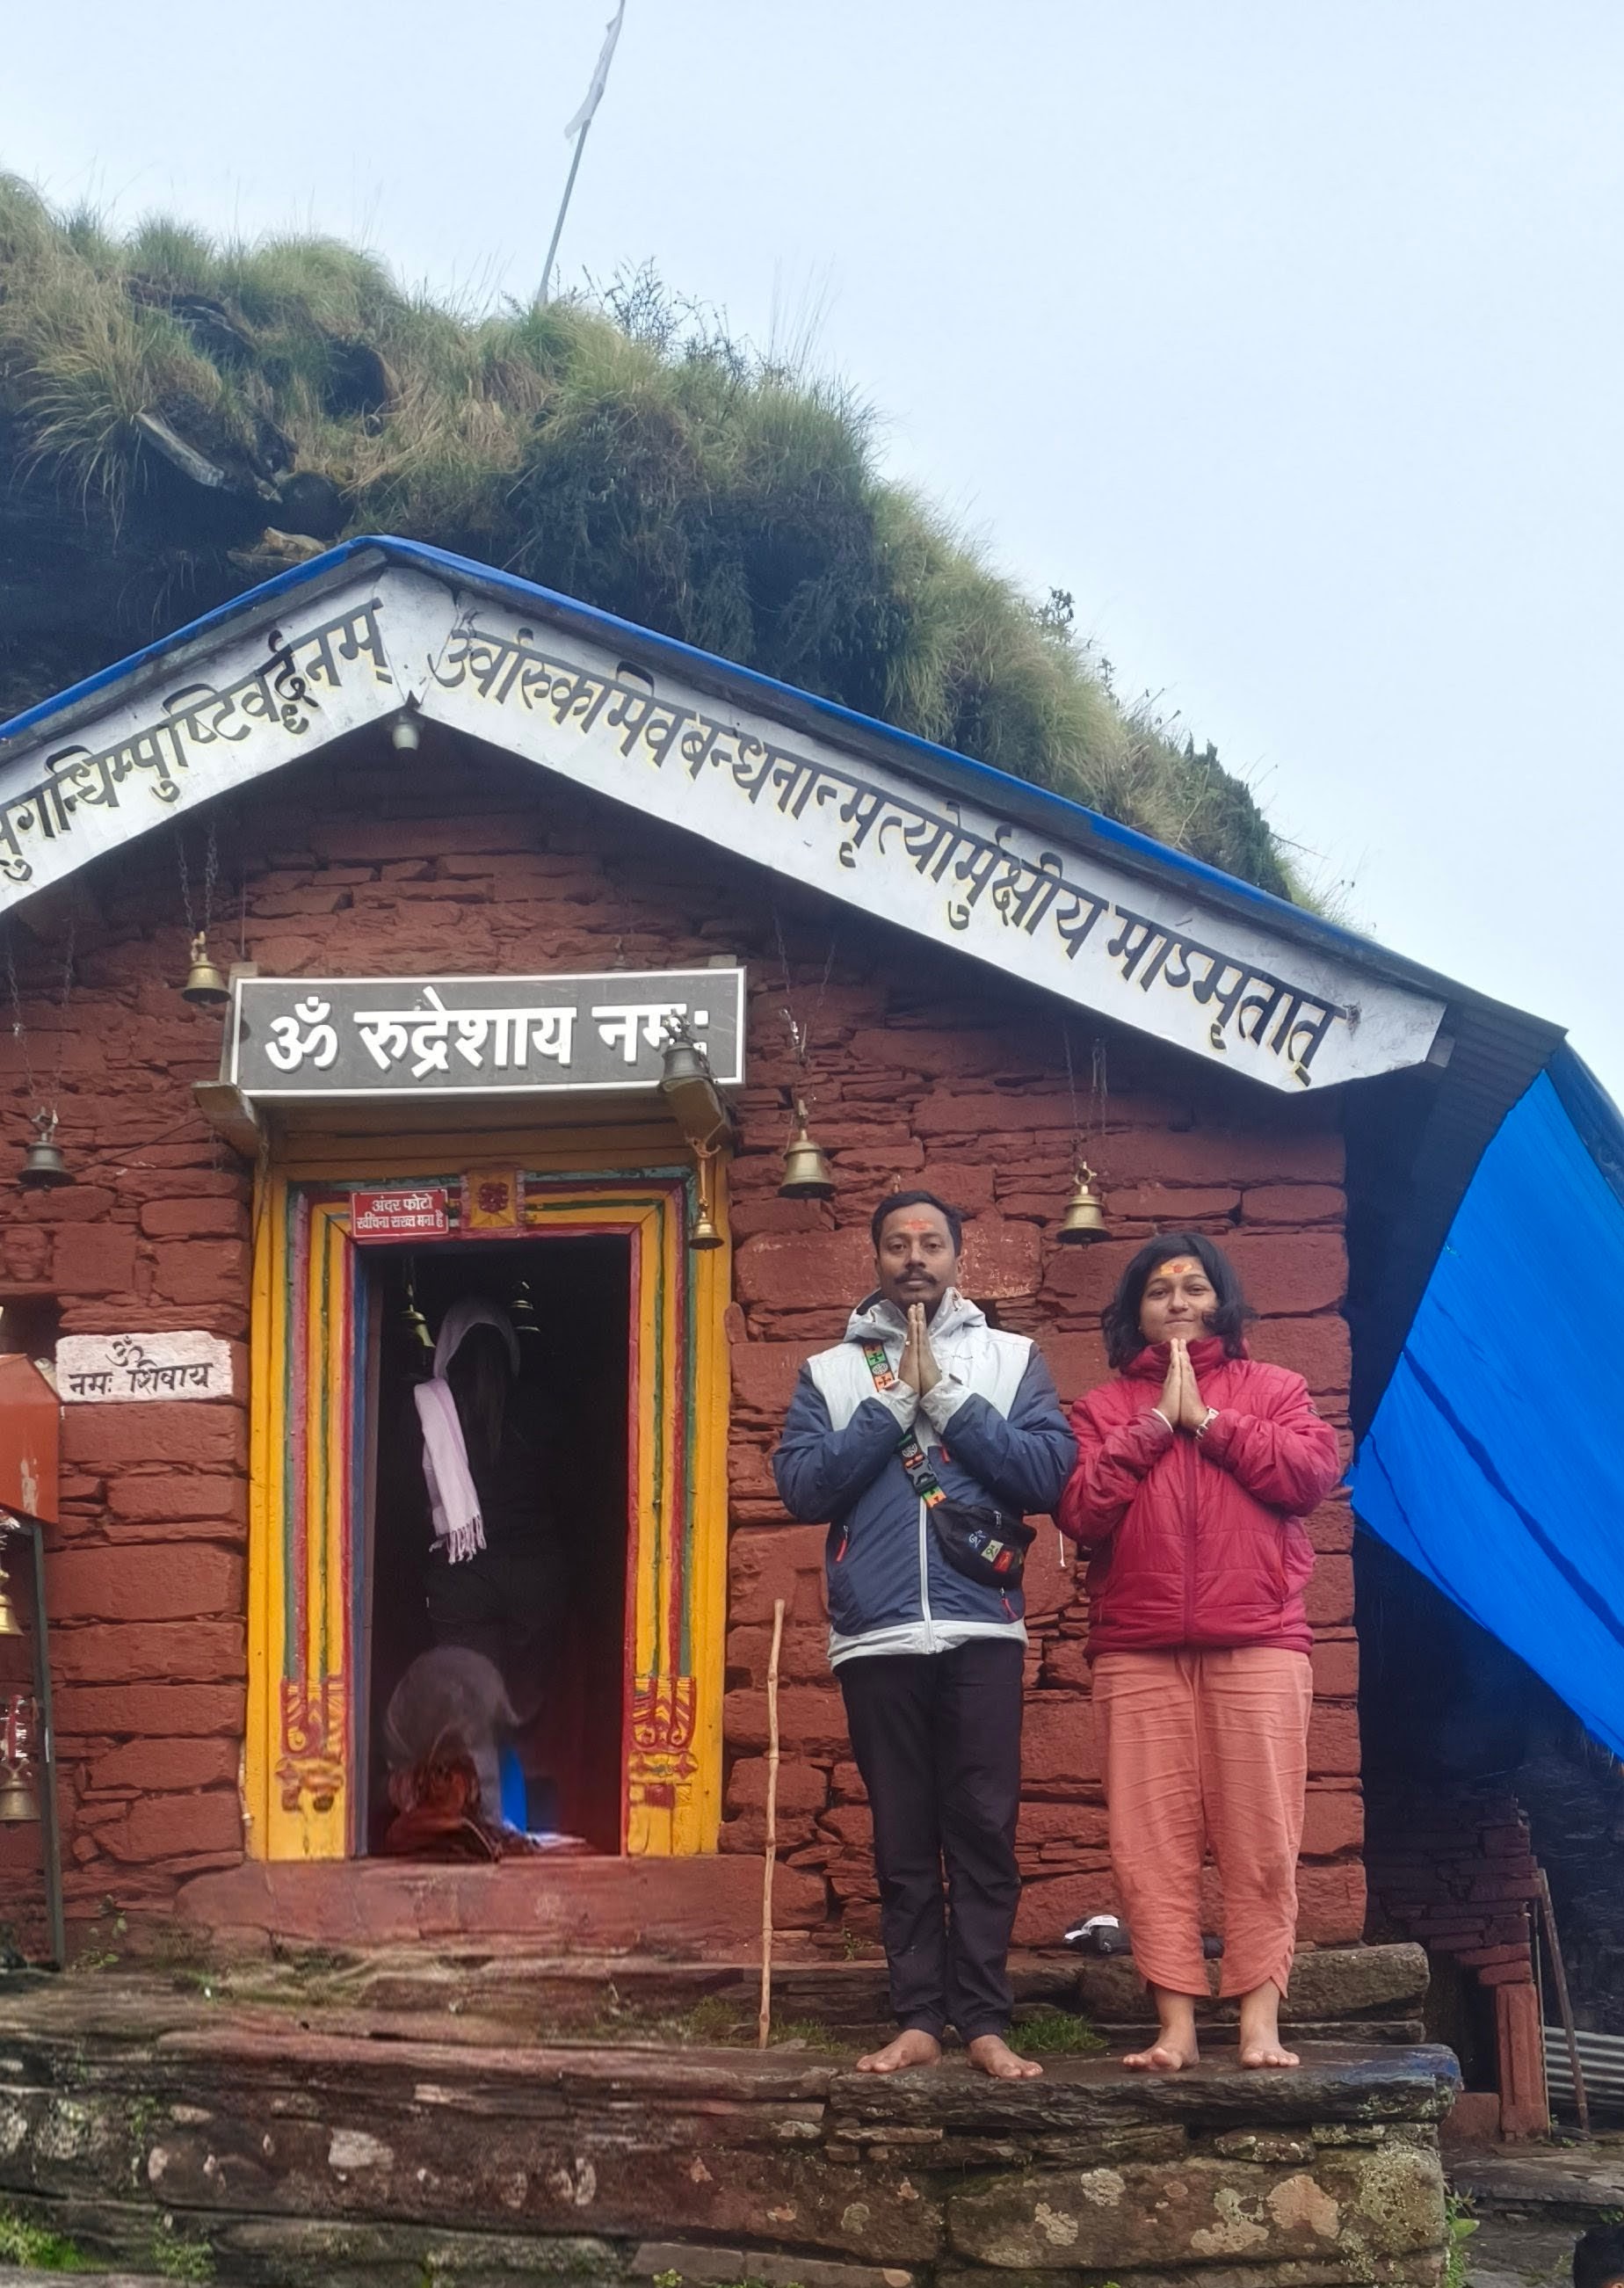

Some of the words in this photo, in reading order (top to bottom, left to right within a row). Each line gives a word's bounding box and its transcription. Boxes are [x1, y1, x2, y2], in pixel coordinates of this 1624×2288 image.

[265, 996, 338, 1073] ॐ
[353, 985, 577, 1080] रुद्रेशाय
[373, 1195, 402, 1212] अंदर
[403, 1193, 433, 1210] फोटो
[390, 1215, 416, 1228] सख्त
[417, 1214, 434, 1226] मना
[435, 1209, 444, 1228] है
[105, 1335, 144, 1367] ॐ
[69, 1371, 113, 1396] नमः
[127, 1359, 214, 1395] शिवाय
